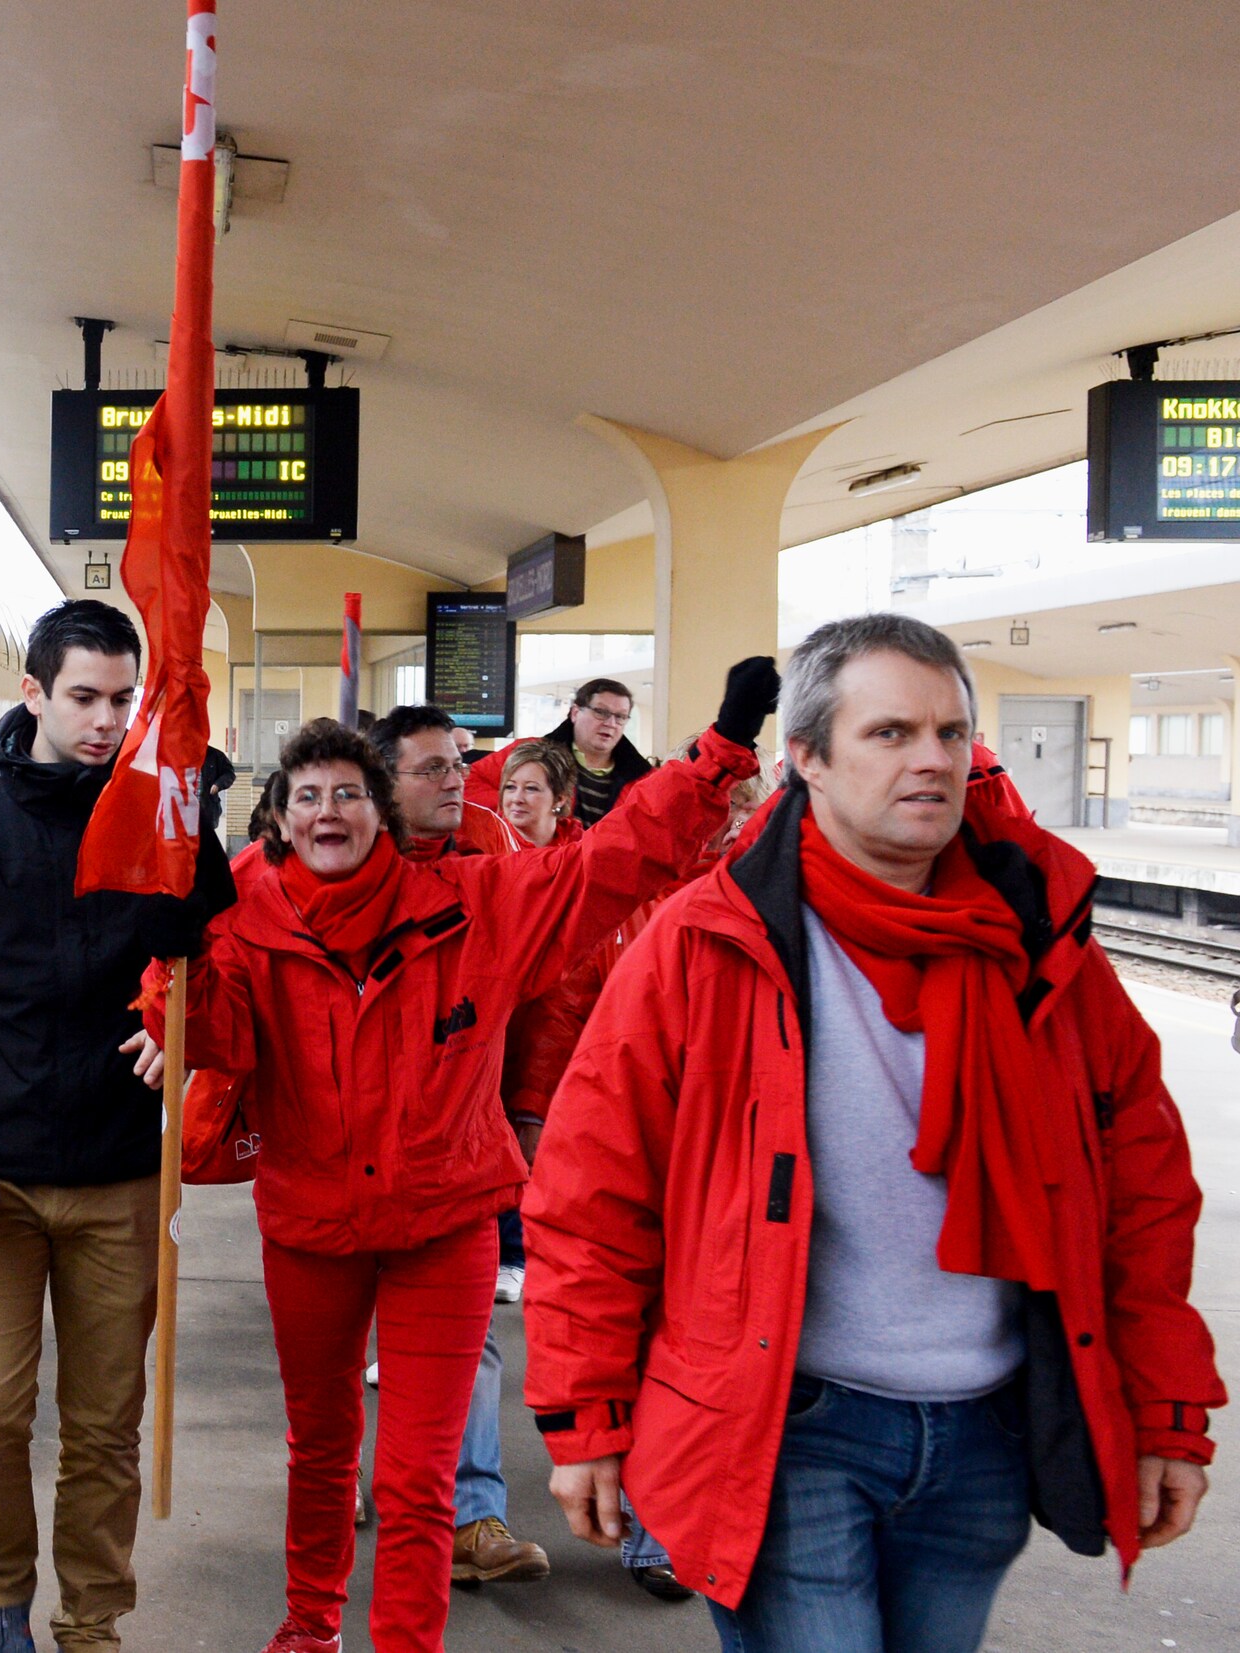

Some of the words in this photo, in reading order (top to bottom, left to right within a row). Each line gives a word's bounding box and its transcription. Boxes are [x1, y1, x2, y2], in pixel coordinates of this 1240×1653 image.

[1163, 398, 1240, 419] Knokk
[280, 461, 306, 480] IC
[1162, 456, 1236, 477] 09:17
